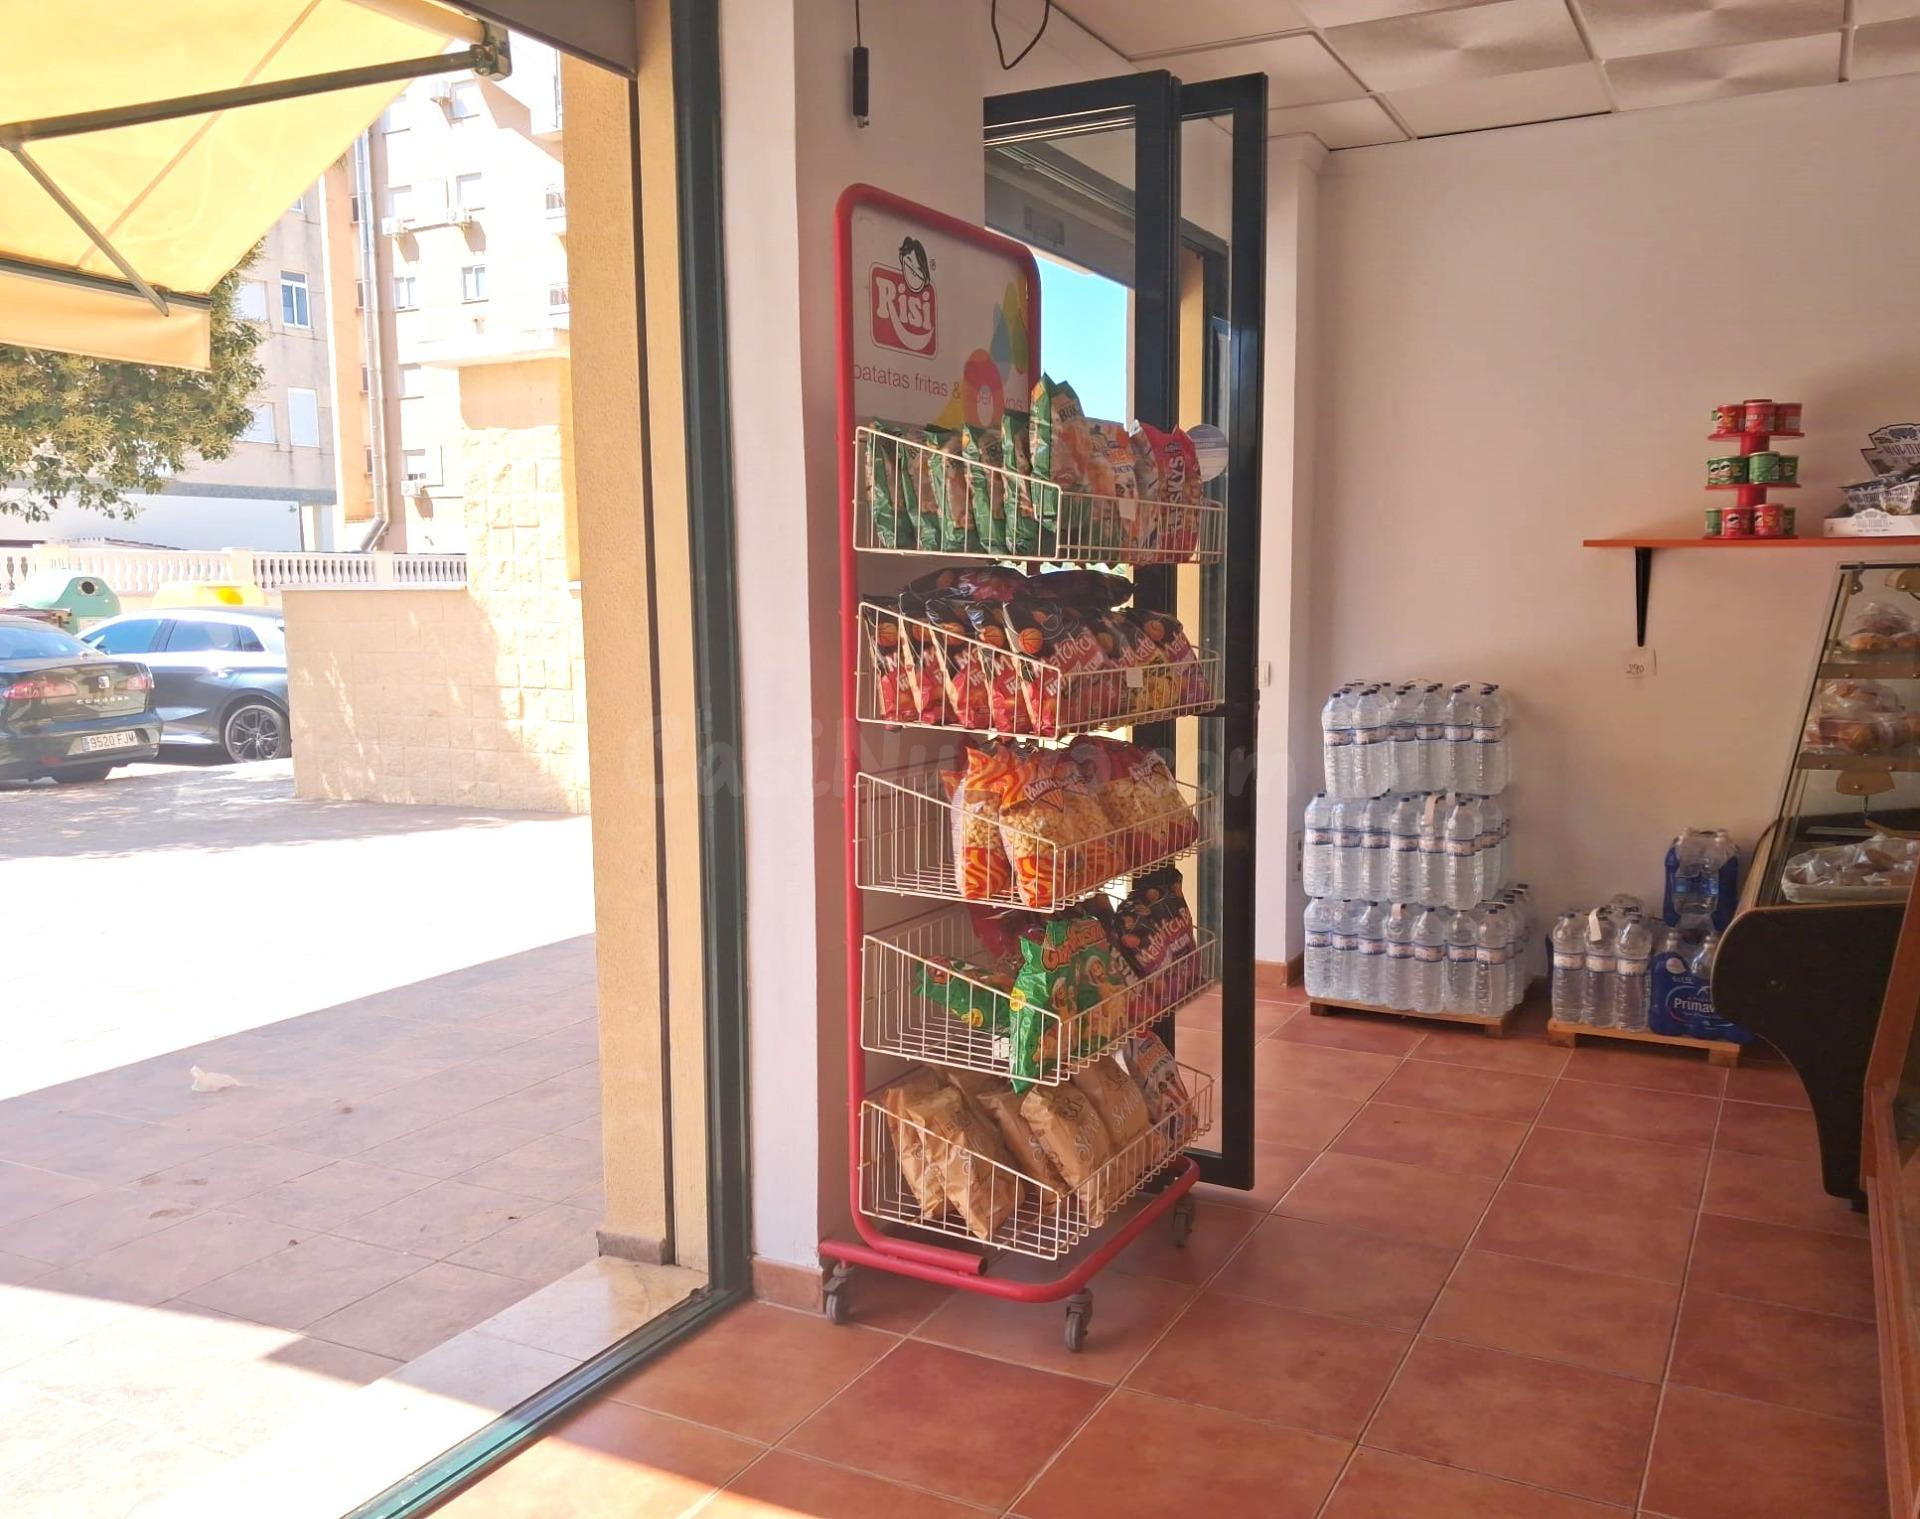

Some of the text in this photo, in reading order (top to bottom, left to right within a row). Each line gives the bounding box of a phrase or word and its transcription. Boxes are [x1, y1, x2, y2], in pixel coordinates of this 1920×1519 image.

[876, 277, 934, 349] Risi
[915, 374, 949, 397] fritas
[951, 381, 961, 399] &
[90, 735, 115, 748] 9520
[1673, 997, 1715, 1013] Primav
